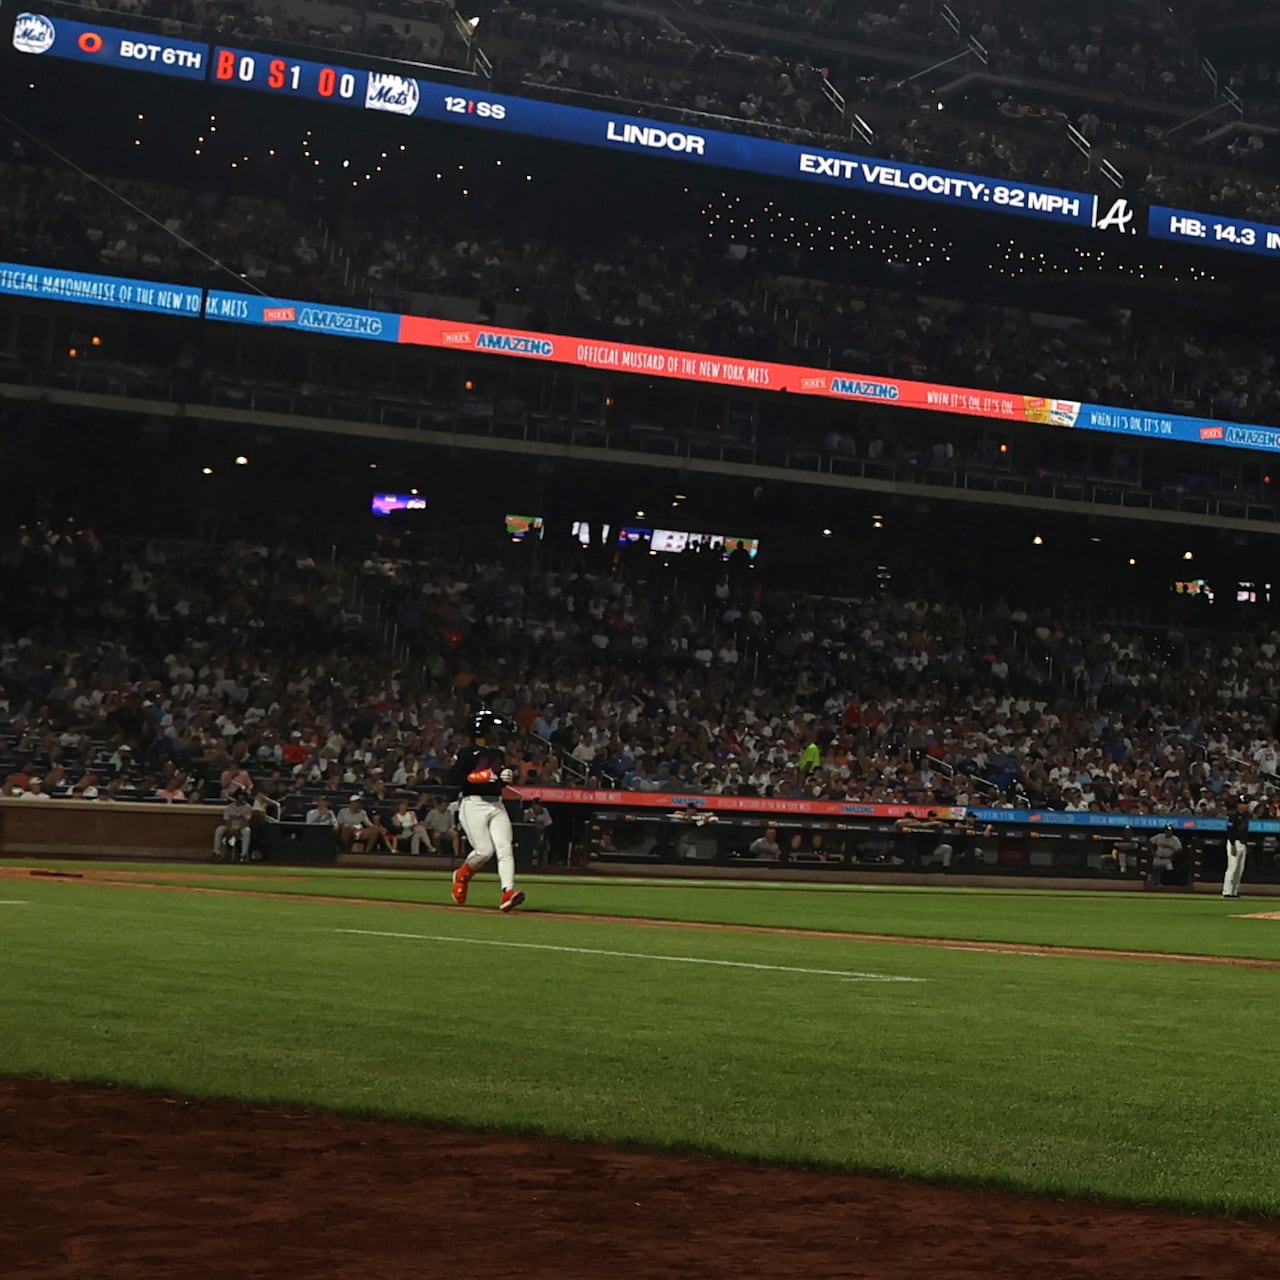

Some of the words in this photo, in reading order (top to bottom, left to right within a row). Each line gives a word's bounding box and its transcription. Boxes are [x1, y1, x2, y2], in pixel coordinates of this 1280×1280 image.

[120, 41, 160, 61] BOT
[162, 48, 201, 68] 6TH
[370, 86, 408, 106] Mets
[476, 102, 506, 119] SS
[607, 121, 705, 155] LINDOR
[800, 154, 857, 179] EXIT
[862, 164, 990, 201] VELOCITY:
[993, 186, 1025, 208] 82
[1028, 195, 1080, 216] MPH
[1170, 216, 1206, 237] HB:
[1213, 224, 1256, 246] 14.3
[42, 277, 115, 301] MAYONNAISE
[120, 285, 131, 302] OF
[136, 287, 154, 305] THE
[157, 291, 181, 310] NEW
[221, 299, 248, 318] METS
[299, 308, 382, 335] AMAZING
[475, 332, 554, 357] AMAZING
[577, 345, 619, 365] OFFICIAL
[622, 350, 664, 370] MUSTARD
[667, 356, 679, 372] OF
[682, 358, 696, 375] THE
[700, 361, 720, 378] NEW
[722, 364, 744, 381] YORK
[747, 367, 769, 385] METS
[831, 378, 899, 400] AMAZING
